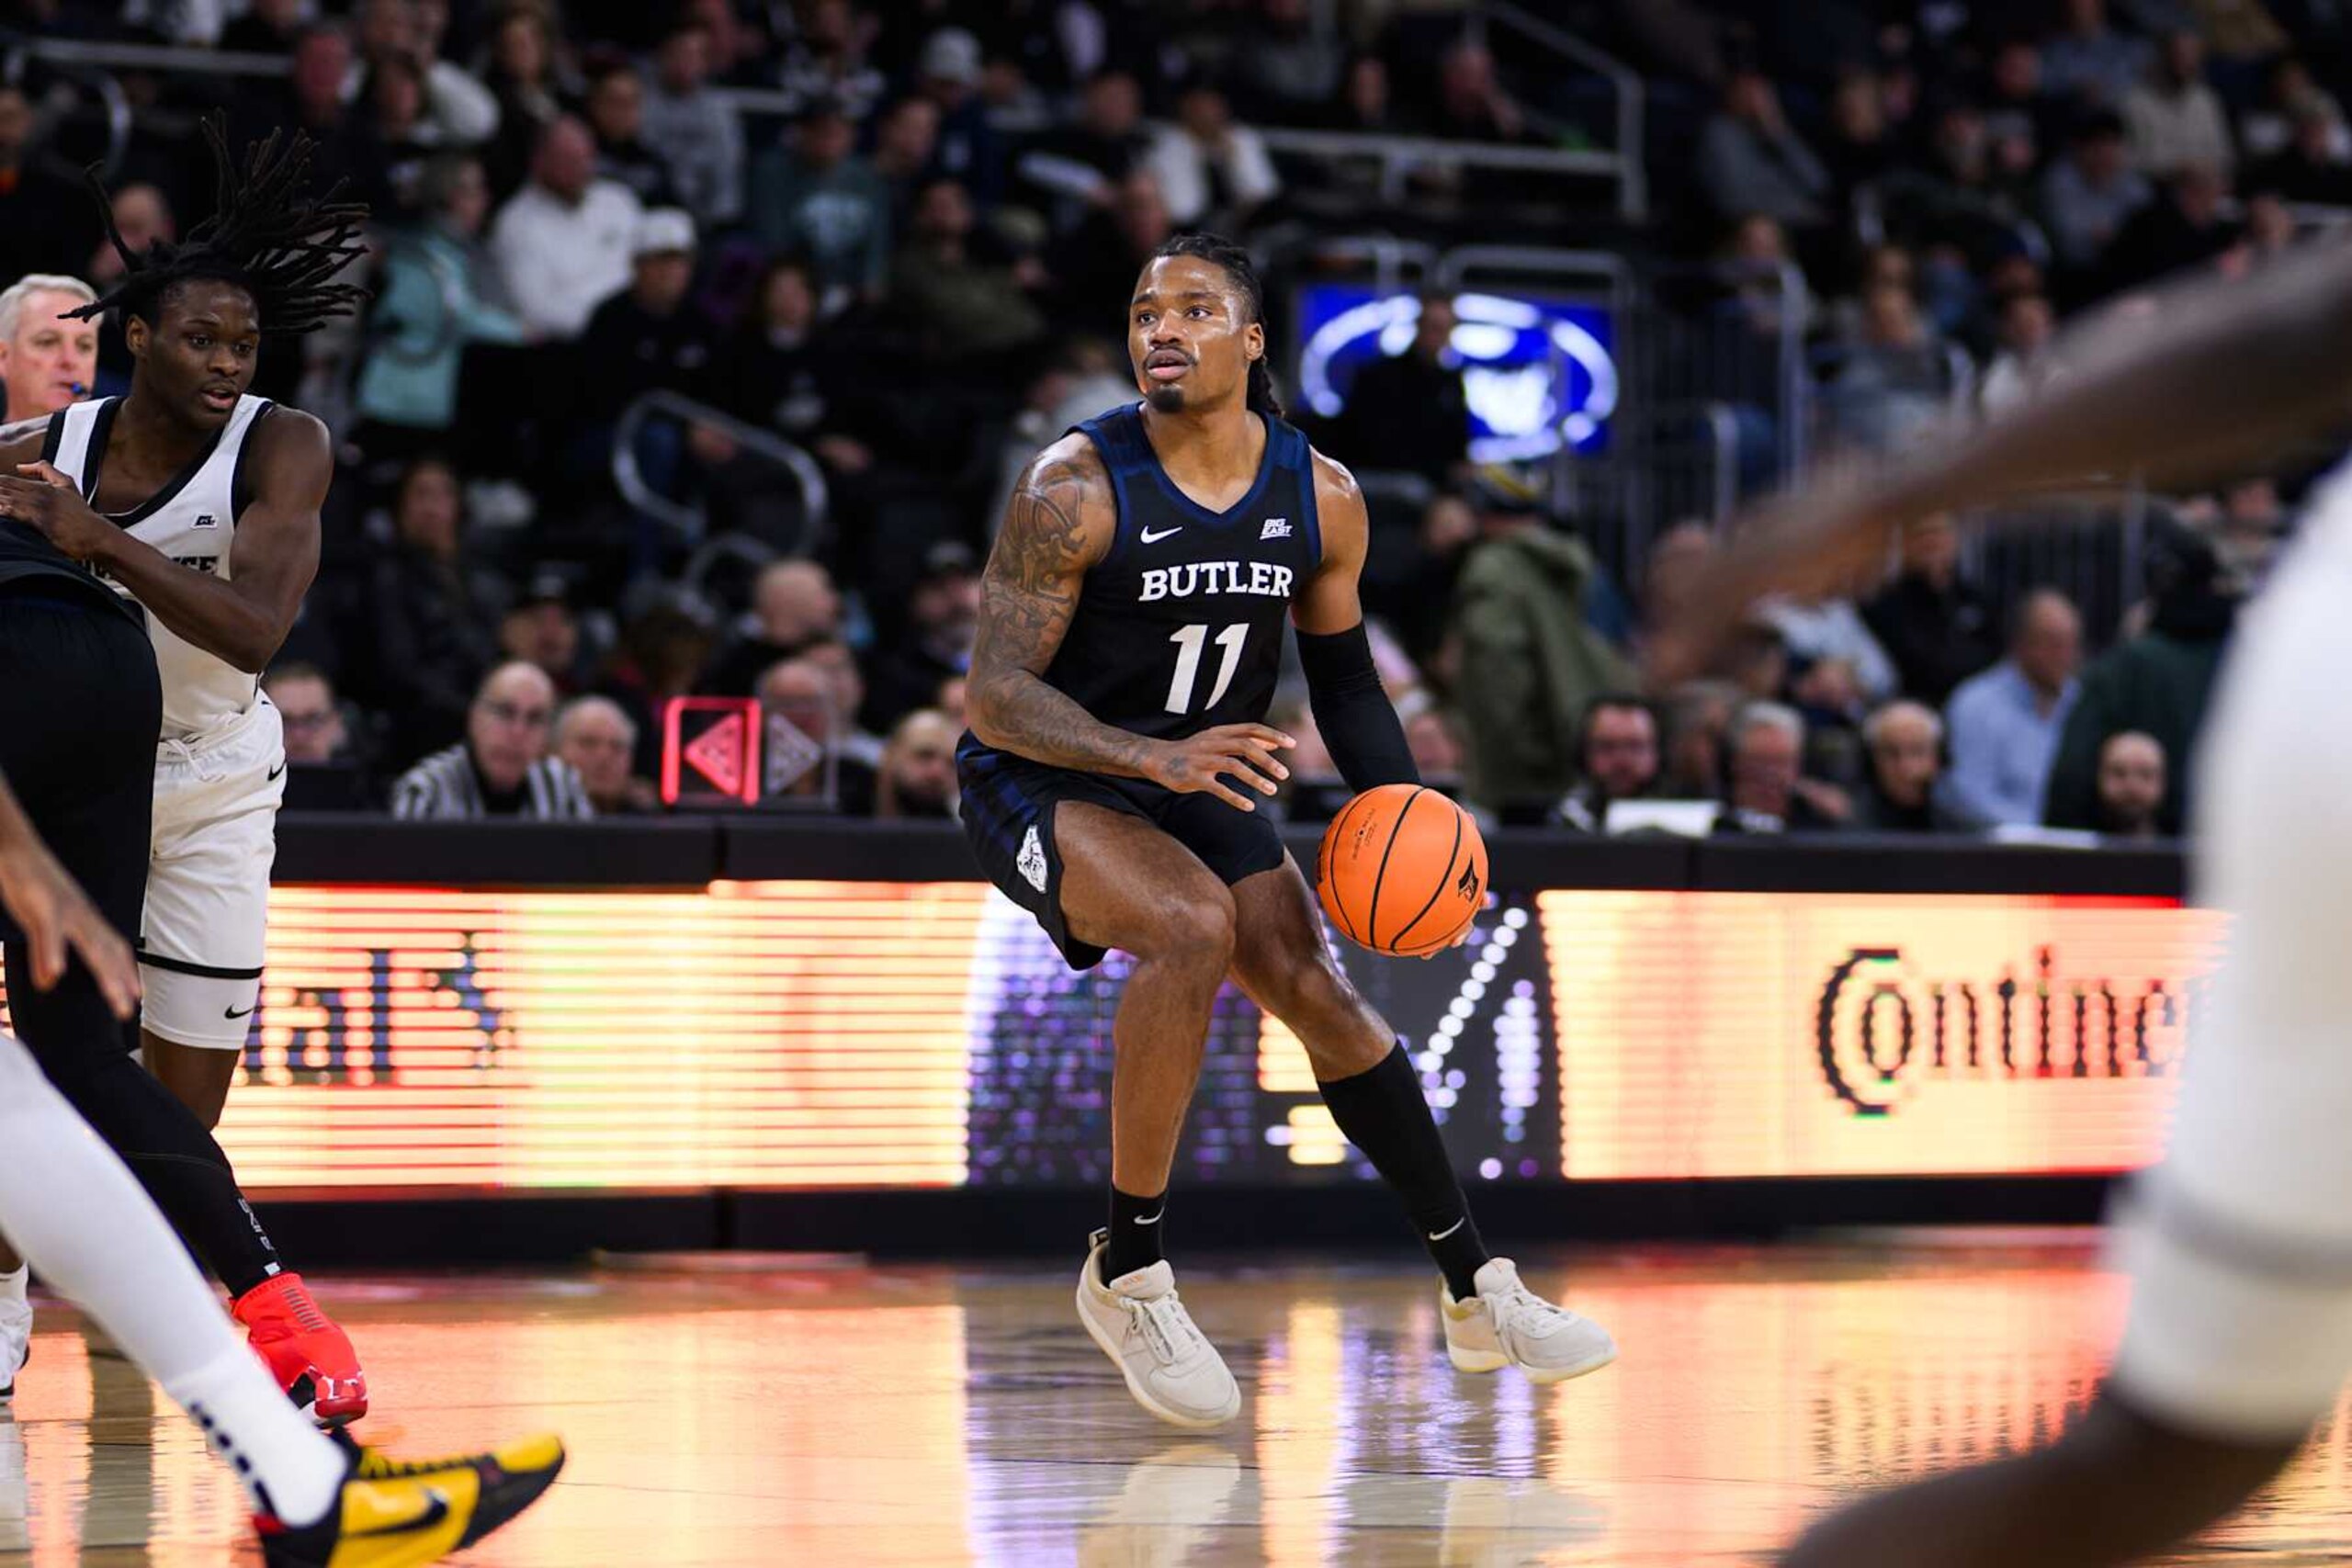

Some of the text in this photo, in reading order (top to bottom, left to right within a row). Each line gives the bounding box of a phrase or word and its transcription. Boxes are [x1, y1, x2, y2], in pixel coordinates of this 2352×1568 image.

[1261, 525, 1293, 536] EAST
[1138, 560, 1294, 602] BUTLER
[1164, 623, 1250, 715] 11
